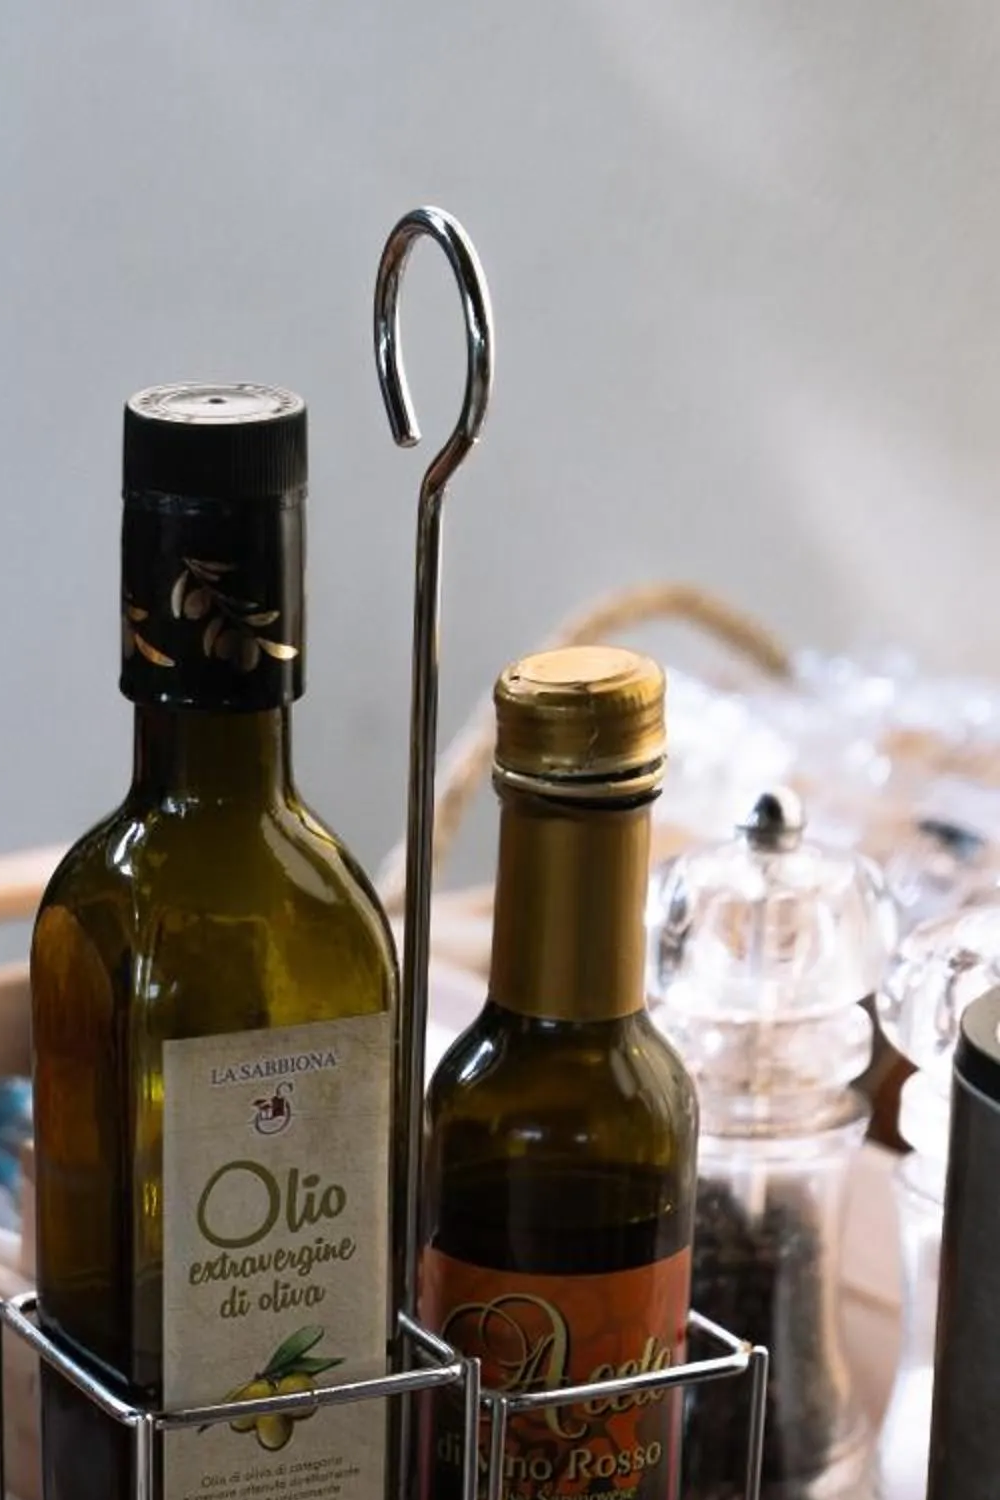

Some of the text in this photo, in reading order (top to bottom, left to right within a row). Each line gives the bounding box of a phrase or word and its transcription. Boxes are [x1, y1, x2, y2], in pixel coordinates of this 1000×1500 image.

[211, 1052, 338, 1085] LA SABBIONA
[197, 1160, 347, 1249] Olio
[189, 1237, 356, 1286] extravergine
[220, 1280, 326, 1318] di oliva
[567, 1441, 662, 1480] Rosso
